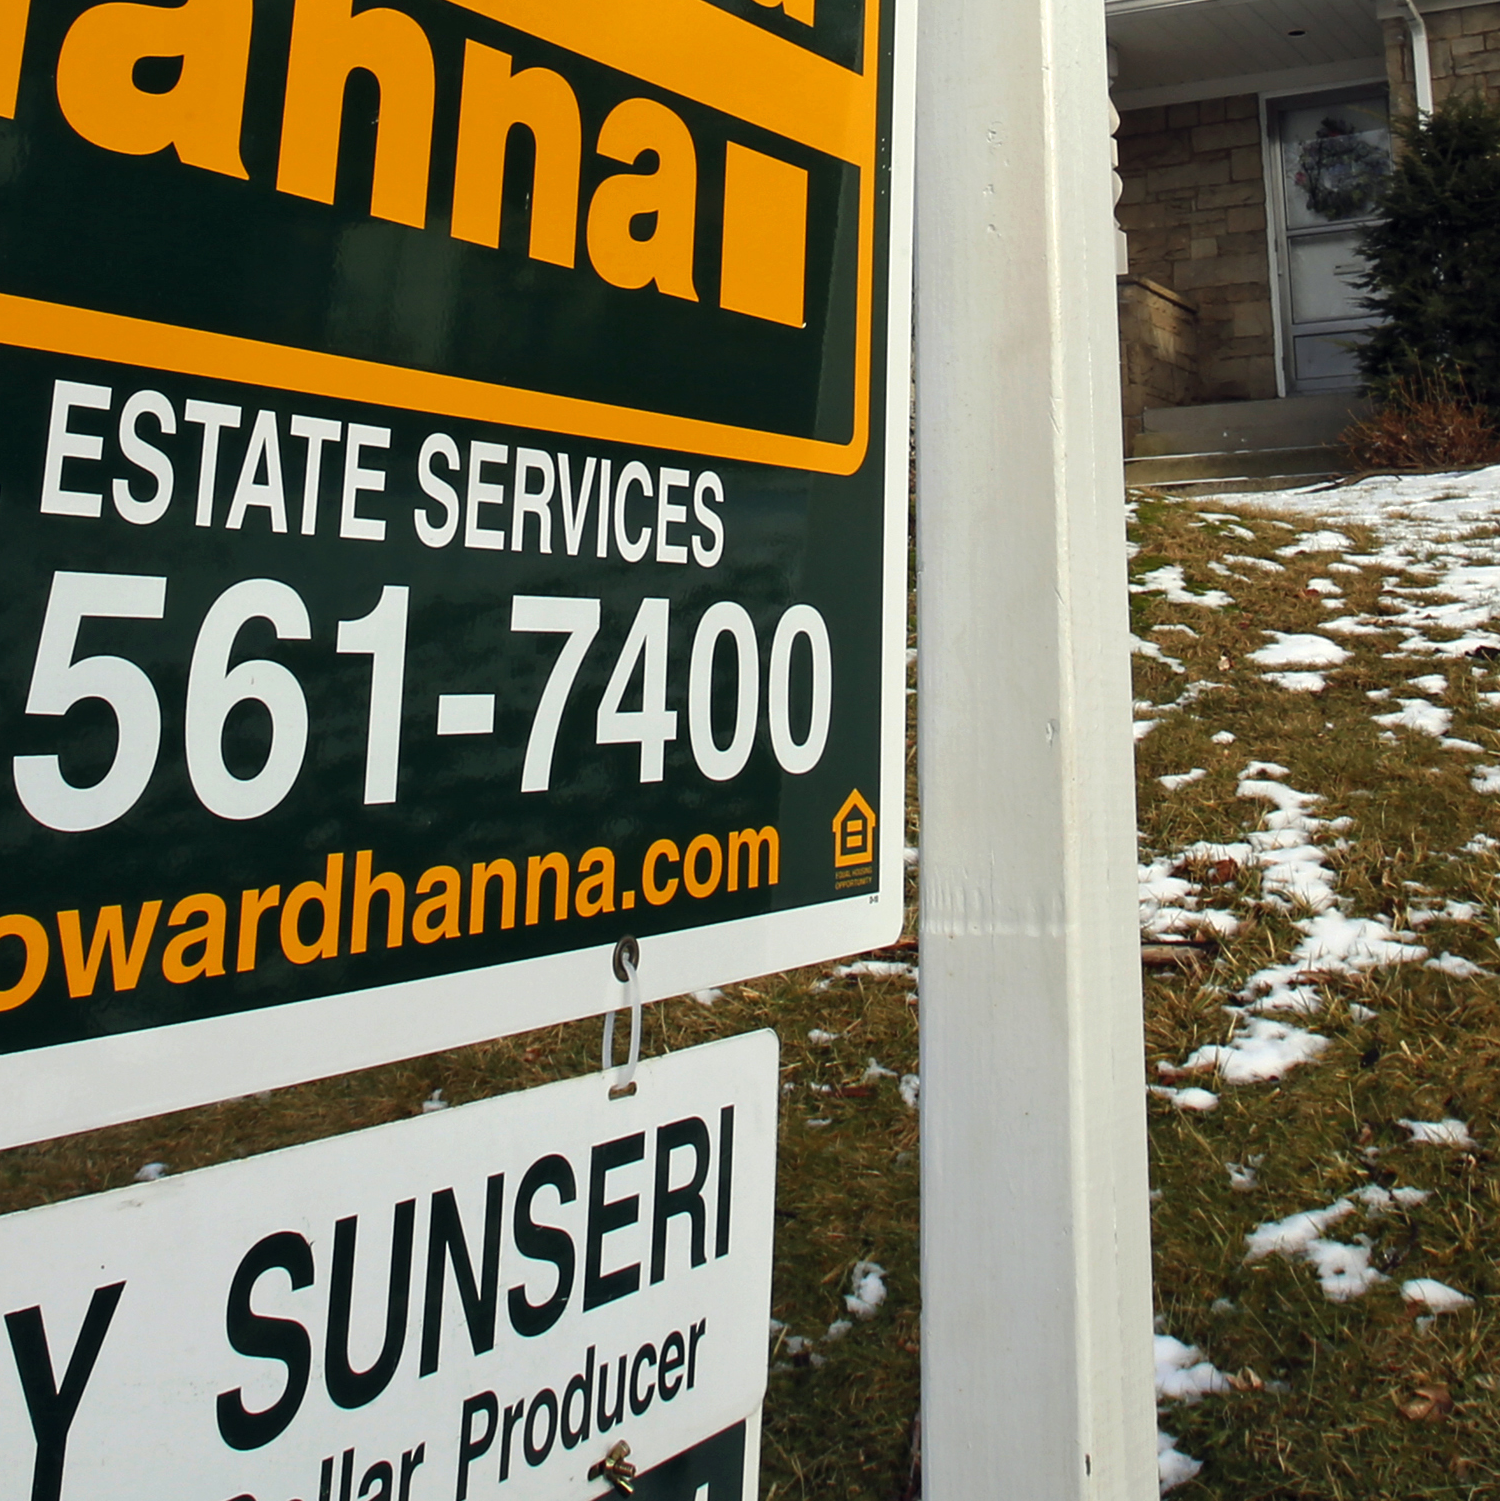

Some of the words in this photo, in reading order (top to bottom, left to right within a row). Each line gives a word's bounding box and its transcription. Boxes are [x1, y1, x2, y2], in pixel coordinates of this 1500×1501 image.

[40, 379, 392, 541] ESTATE
[414, 432, 725, 569] SERVICES
[216, 1105, 734, 1451] SUNSERI
[455, 1318, 707, 1501] Producer
